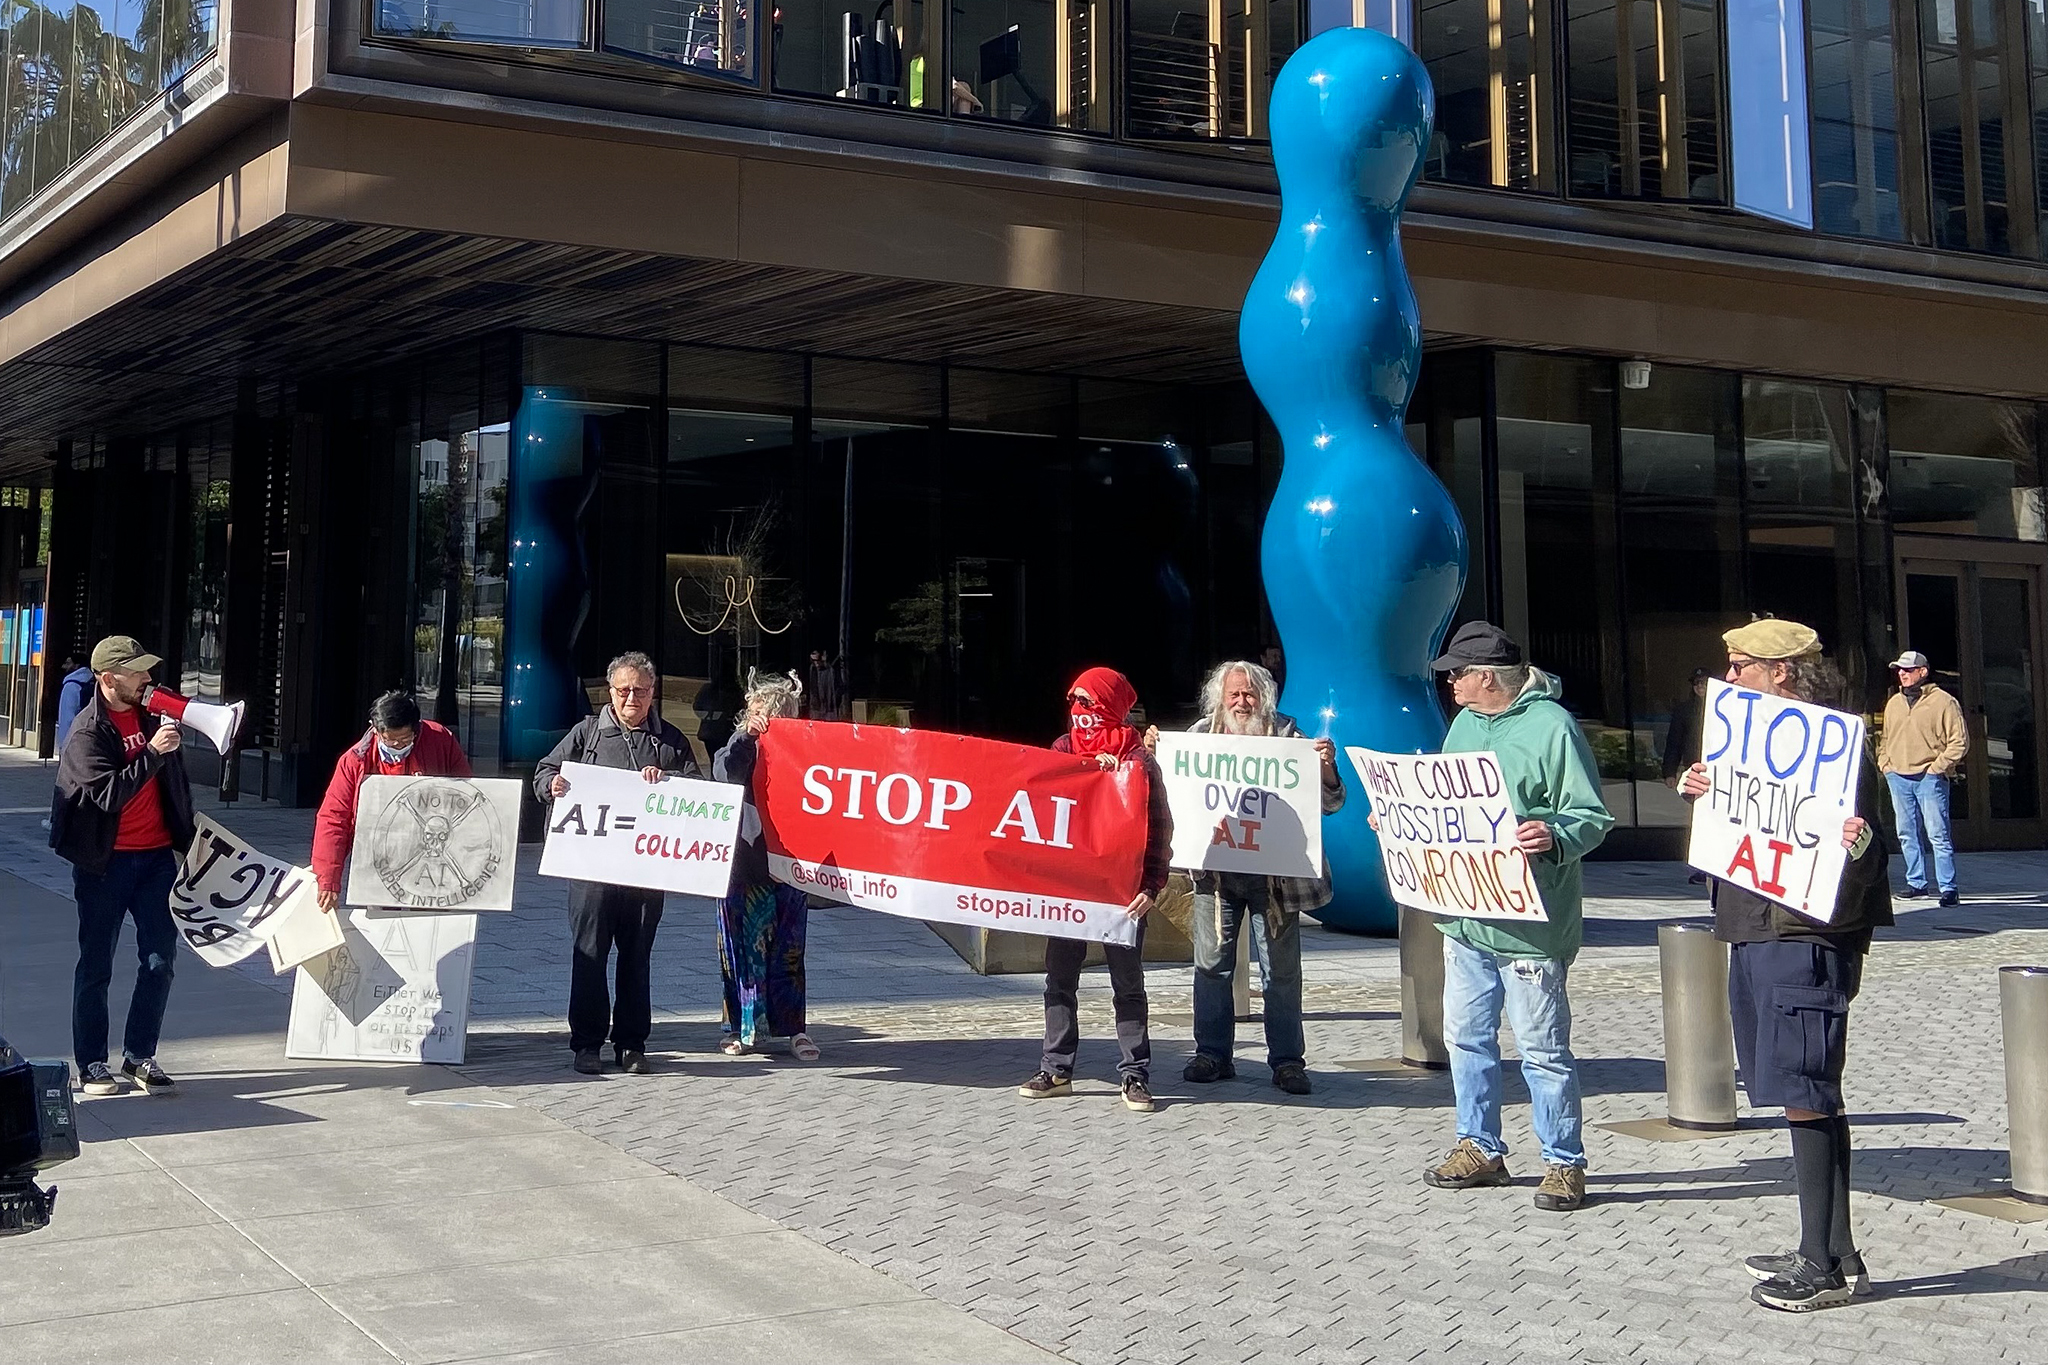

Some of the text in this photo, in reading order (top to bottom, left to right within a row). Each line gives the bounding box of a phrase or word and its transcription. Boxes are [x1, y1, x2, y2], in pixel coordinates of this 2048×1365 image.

[1072, 713, 1104, 729] TOP
[122, 731, 147, 752] STO
[1706, 687, 1859, 807] STOP!
[1360, 756, 1500, 800] WHAT COULD
[645, 792, 736, 822] CLIMATE
[802, 764, 1077, 850] STOP AI
[1375, 797, 1507, 844] POSSIBLY
[1712, 765, 1820, 849] HIRING
[635, 833, 732, 862] COLLAPSE
[1212, 817, 1262, 851] AI
[373, 853, 502, 907] SUPER INTELLIGENCE
[414, 863, 448, 888] AI
[791, 861, 898, 899] @stopai_info
[1387, 846, 1539, 914] GO WRONG?
[956, 892, 1087, 925] stopai.info
